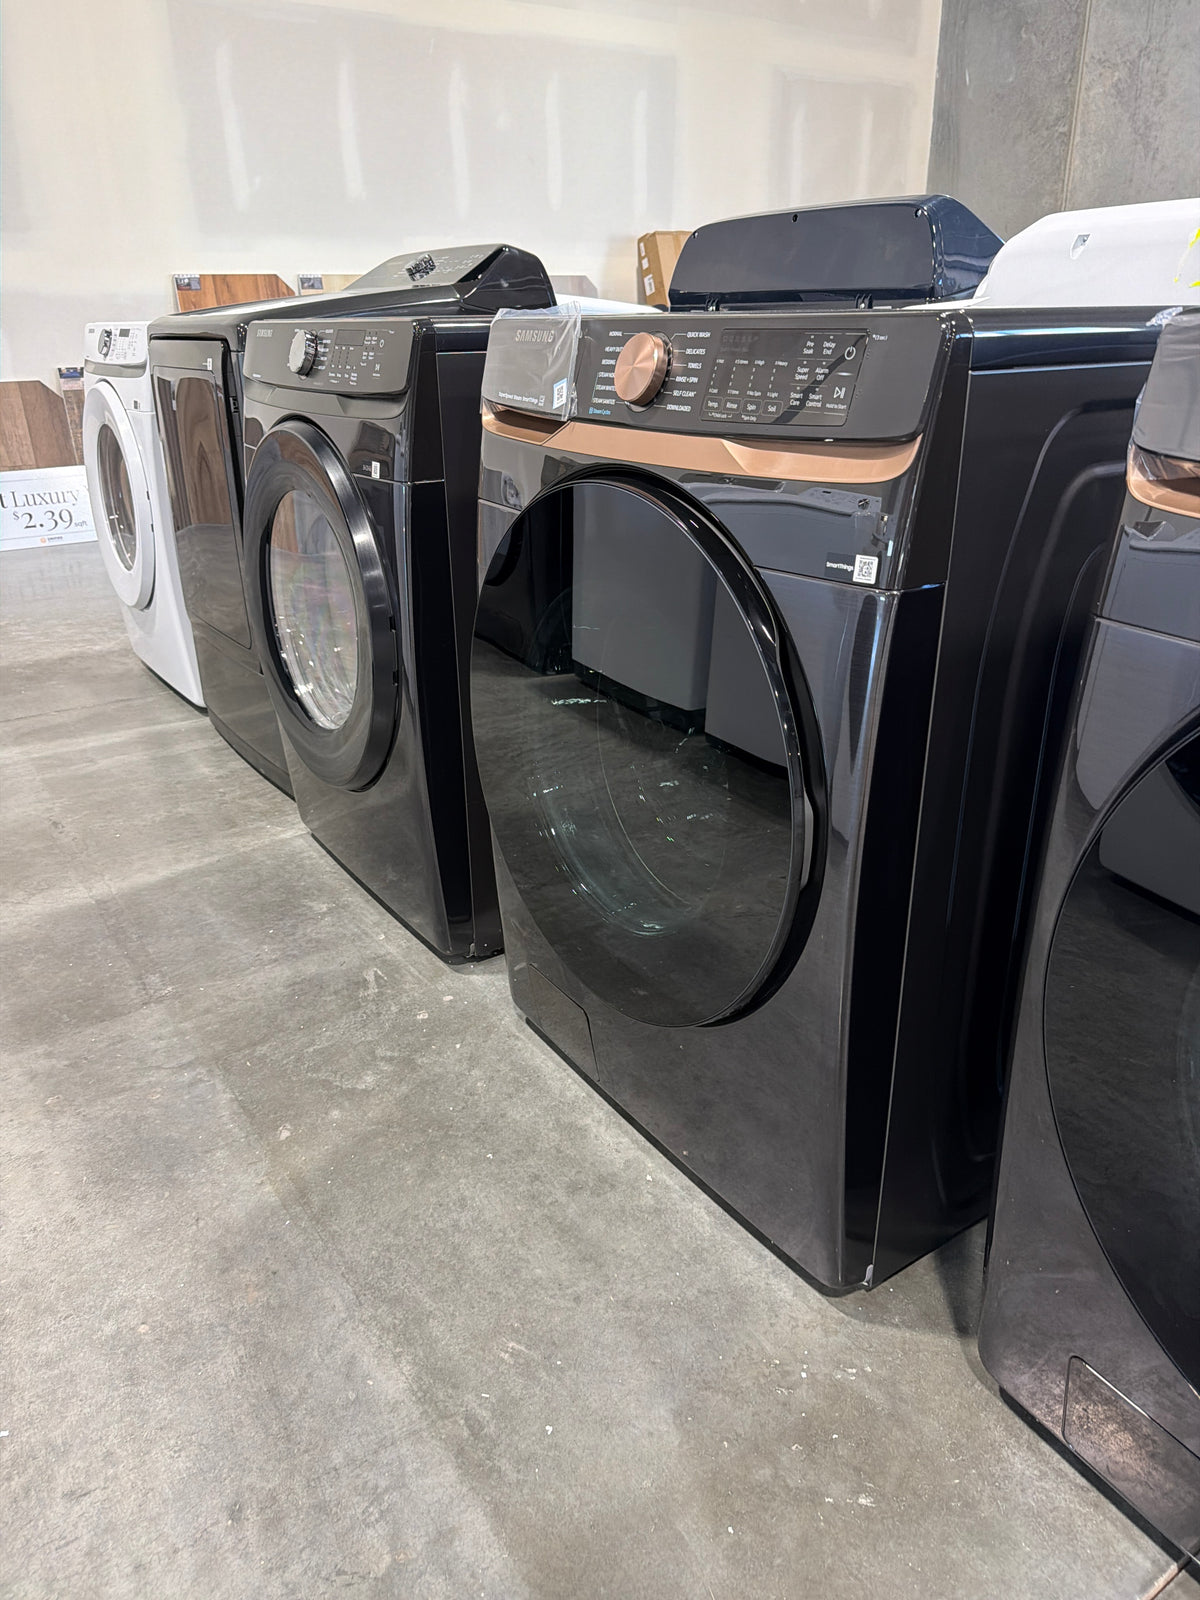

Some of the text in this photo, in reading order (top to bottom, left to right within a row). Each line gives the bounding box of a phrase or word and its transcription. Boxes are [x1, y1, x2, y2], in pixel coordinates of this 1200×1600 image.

[516, 329, 554, 342] SAMSUNG
[666, 404, 691, 412] DOWNLOADED
[10, 490, 80, 508] Luxury
[74, 520, 88, 528] sqft
[826, 562, 853, 572] SmartThings
